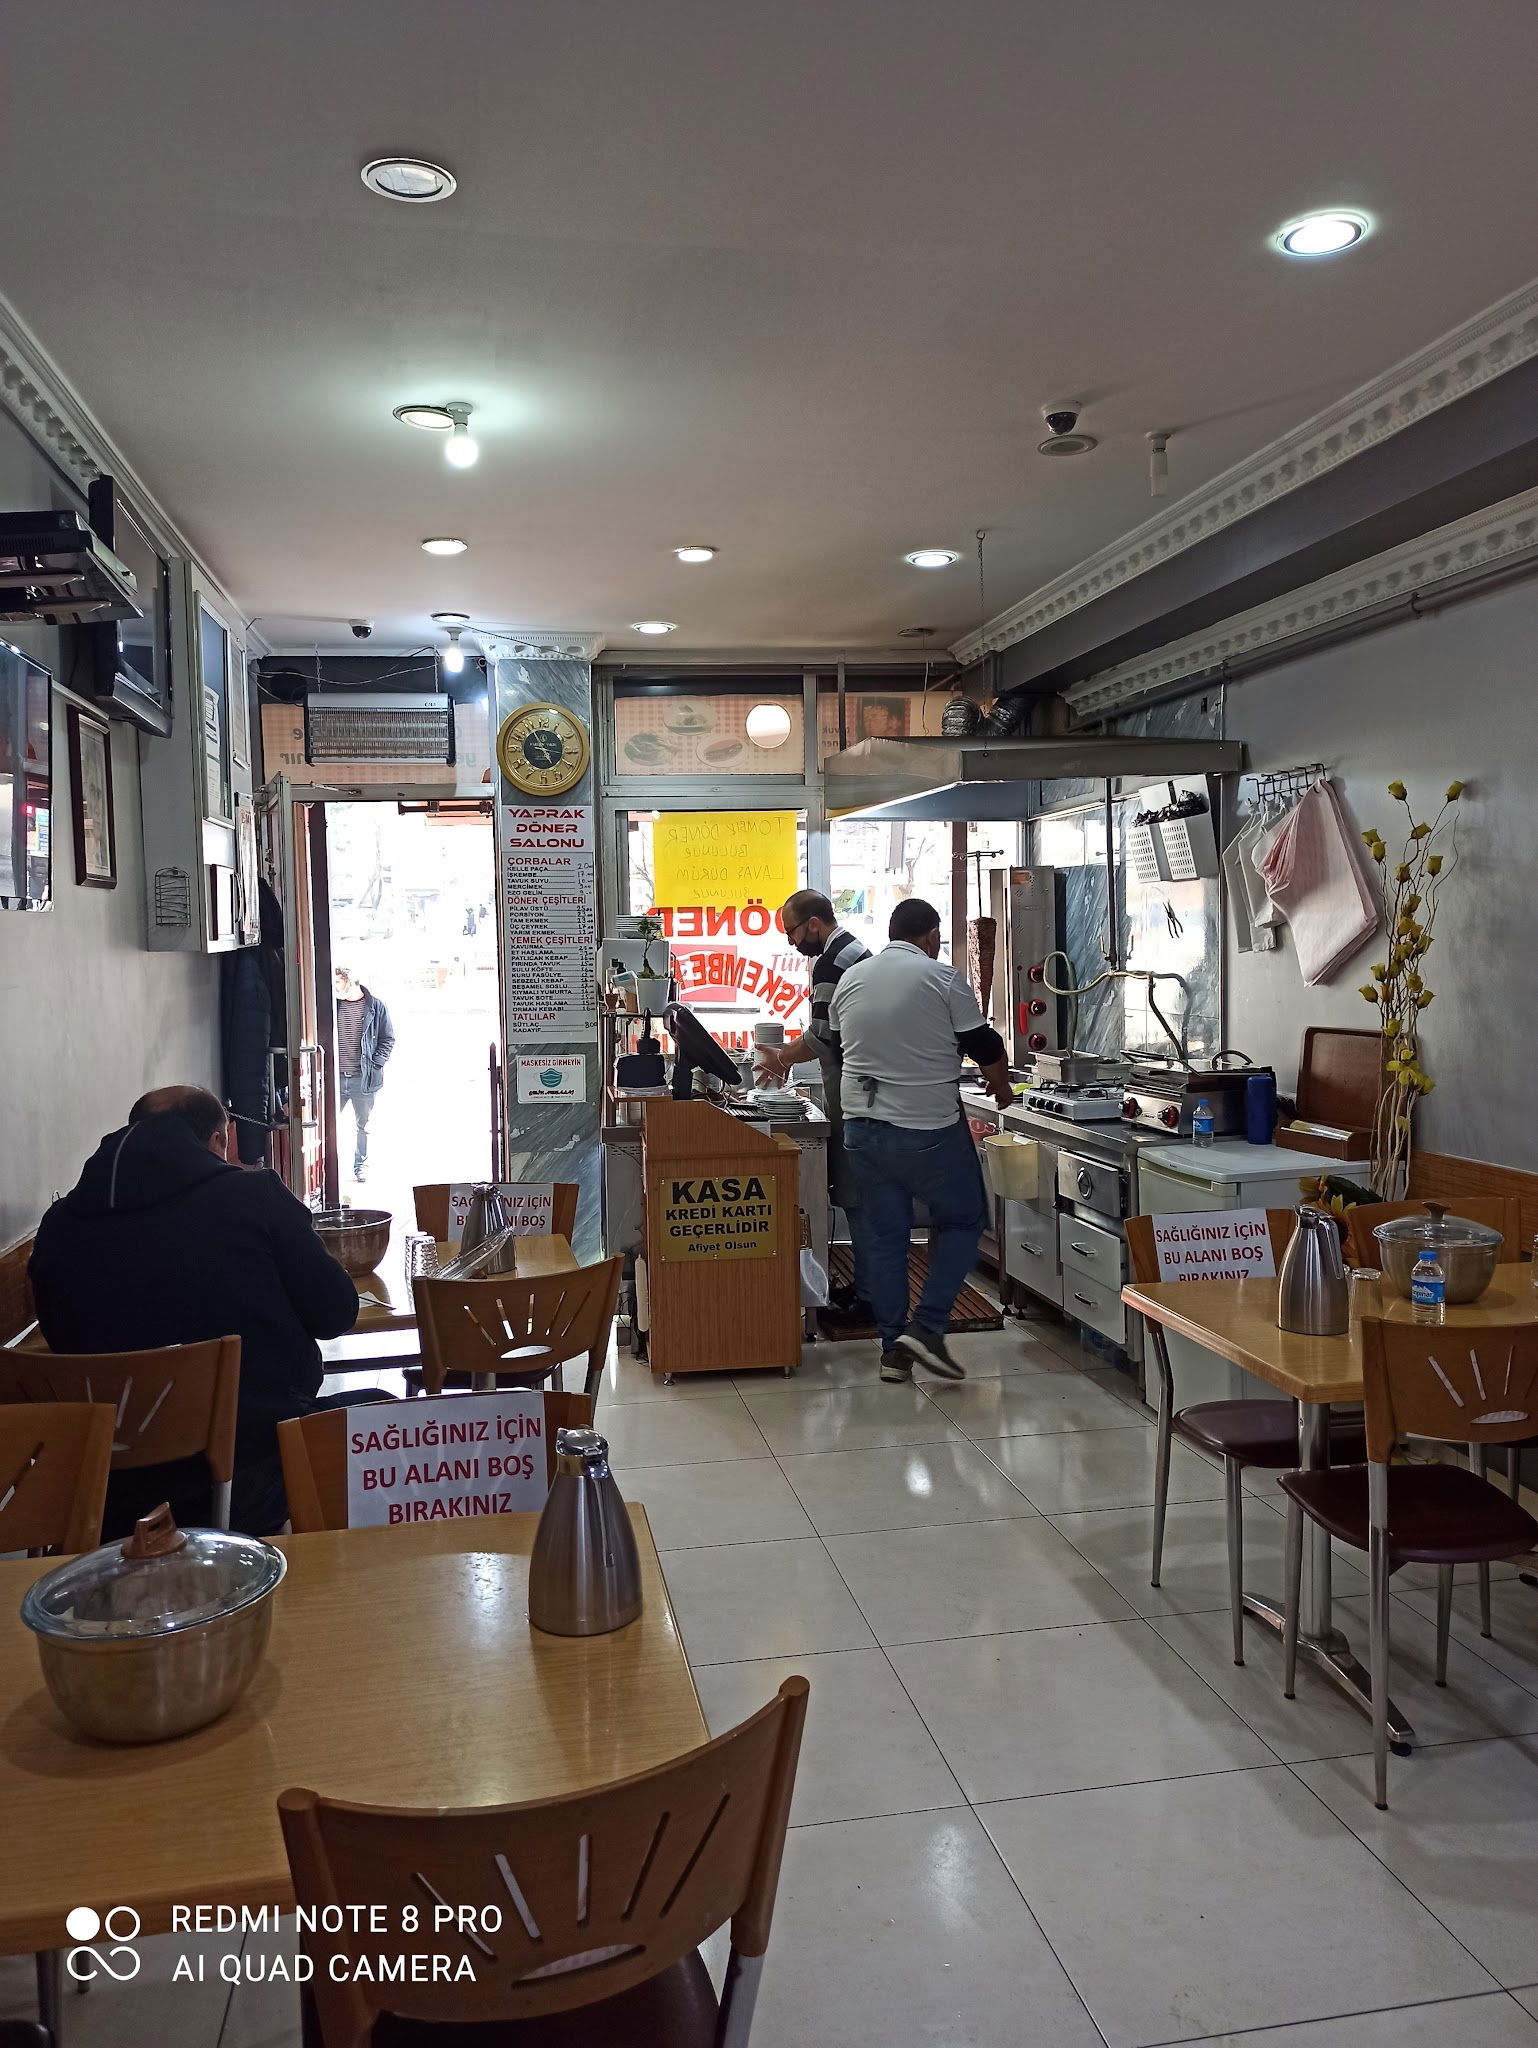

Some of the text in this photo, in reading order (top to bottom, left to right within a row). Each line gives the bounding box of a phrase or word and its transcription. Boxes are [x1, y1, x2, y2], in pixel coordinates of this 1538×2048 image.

[508, 808, 585, 819] YAPRAK
[516, 821, 578, 833] DÖNER
[509, 838, 585, 848] SALONU
[507, 857, 571, 867] ÇORBALAR
[507, 894, 586, 905] DÖNER ÇEŞİTLERİ
[510, 934, 593, 945] YEMEK ÇEŞİTLERİ
[512, 1013, 556, 1021] TATLILAR
[521, 1057, 581, 1067] MASKESİZ GİRMEYİN
[672, 1177, 767, 1205] KASA
[451, 1195, 551, 1210] SANIZ İÇİN
[665, 1204, 772, 1221] KREDİ KARTI
[521, 1215, 546, 1228] BOŞ
[669, 1218, 769, 1239] GEÇERLİDİR
[1156, 1221, 1266, 1243] SAĞLIĞINIZ İÇİN
[688, 1241, 757, 1254] Afiyet Olsun
[1164, 1245, 1264, 1265] BU ALANI BOŞ
[351, 1413, 542, 1454] SAĞLIĞINIZ İÇİN
[363, 1454, 534, 1491] BU ALANI BOŞ
[388, 1492, 513, 1525] BIRAKINIZ
